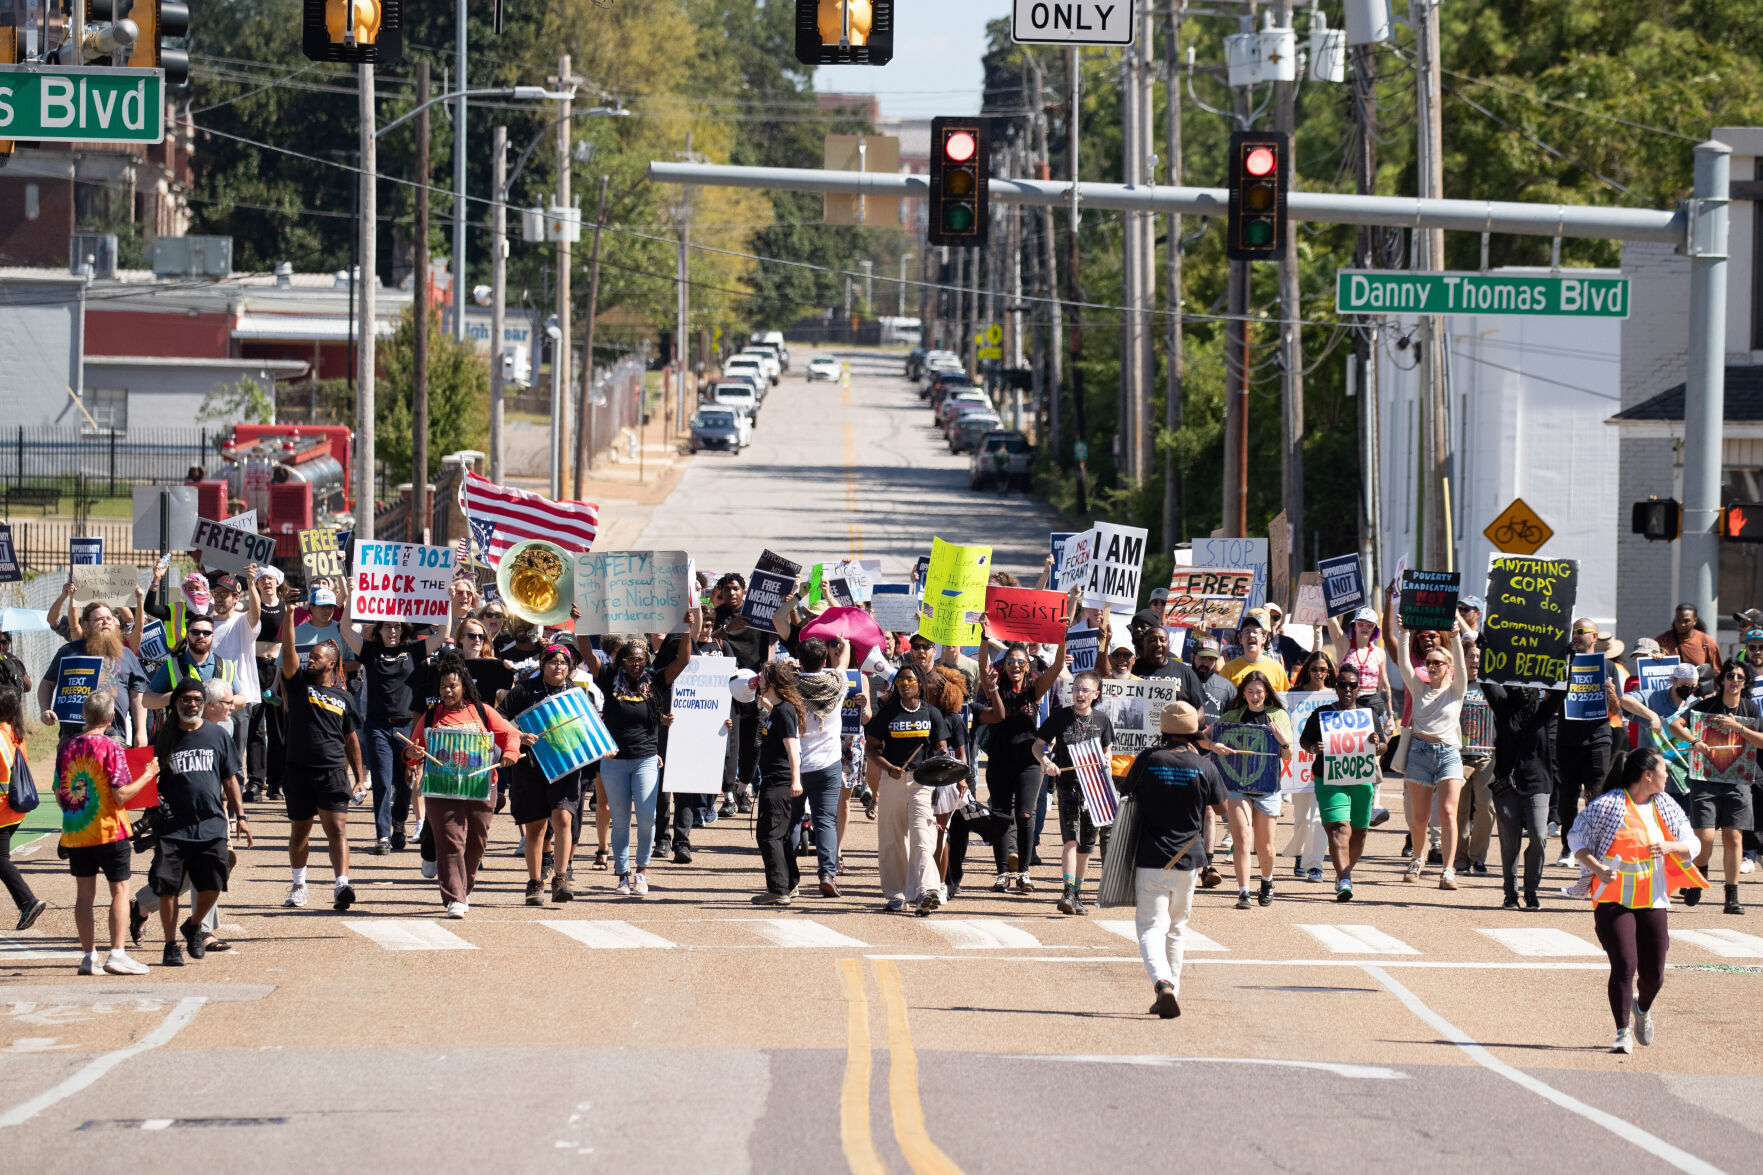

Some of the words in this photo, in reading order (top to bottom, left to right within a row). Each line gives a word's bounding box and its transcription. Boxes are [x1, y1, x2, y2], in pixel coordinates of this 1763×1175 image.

[1031, 3, 1115, 31] ONLY
[41, 77, 146, 130] Blvd
[1350, 276, 1431, 309] Danny
[1443, 278, 1546, 311] Thomas
[1560, 280, 1622, 312] Blvd
[195, 521, 244, 555] FREE
[244, 534, 273, 565] 901
[300, 528, 339, 553] FREE
[1076, 539, 1088, 552] NO
[1092, 531, 1102, 560] I
[1105, 533, 1144, 567] AM
[75, 555, 94, 565] NOT
[360, 545, 402, 566] FREE
[418, 546, 451, 569] 901
[1206, 539, 1254, 565] STOP
[79, 568, 97, 578] YOU
[103, 567, 121, 575] ARE
[303, 551, 343, 577] 901
[578, 552, 648, 578] SAFETY
[649, 560, 688, 579] begins
[1322, 561, 1357, 578] OPPORTUNITY
[1494, 558, 1571, 578] ANYTHING
[358, 572, 416, 594] BLOCK
[420, 579, 445, 590] THE
[578, 578, 601, 590] with
[1088, 564, 1099, 593] A
[1102, 566, 1138, 599] MAN
[1186, 573, 1249, 597] FREE
[1413, 571, 1452, 580] POVERTY
[92, 590, 120, 600] MONEY
[761, 578, 782, 594] FREE
[1331, 576, 1353, 596] NOT
[1402, 580, 1459, 592] ERADICATION
[1510, 576, 1557, 596] COPS
[356, 595, 449, 617] OCCUPATION
[578, 590, 621, 614] Tyre
[1168, 595, 1231, 617] Palestine
[1329, 592, 1361, 608] OCCUPATION
[1416, 591, 1447, 603] NOT
[1500, 593, 1526, 606] can
[601, 609, 665, 622] murderers
[751, 603, 777, 620] MANE
[1487, 614, 1565, 641] Community
[141, 639, 161, 659] NOT
[1511, 636, 1539, 647] CAN
[1072, 650, 1094, 669] NOT
[1484, 648, 1507, 674] DO
[1515, 652, 1567, 681] BETTER
[68, 676, 87, 686] TEXT
[1569, 683, 1600, 693] FREE901
[1574, 674, 1593, 684] TEXT
[61, 685, 91, 695] FREE901
[675, 687, 696, 697] WITH
[1126, 685, 1144, 698] IN
[1148, 686, 1174, 701] 1968
[1567, 692, 1577, 702] TO
[1578, 691, 1604, 702] 25225
[57, 696, 67, 705] TO
[673, 698, 719, 710] OCCUPATION
[841, 708, 859, 717] 225
[1320, 710, 1370, 732] FOOD
[1329, 731, 1367, 755] NOT
[171, 749, 198, 760] ESPECT
[197, 749, 214, 757] THIS
[169, 755, 214, 775] MELANIN
[1325, 754, 1375, 781] TROOPS
